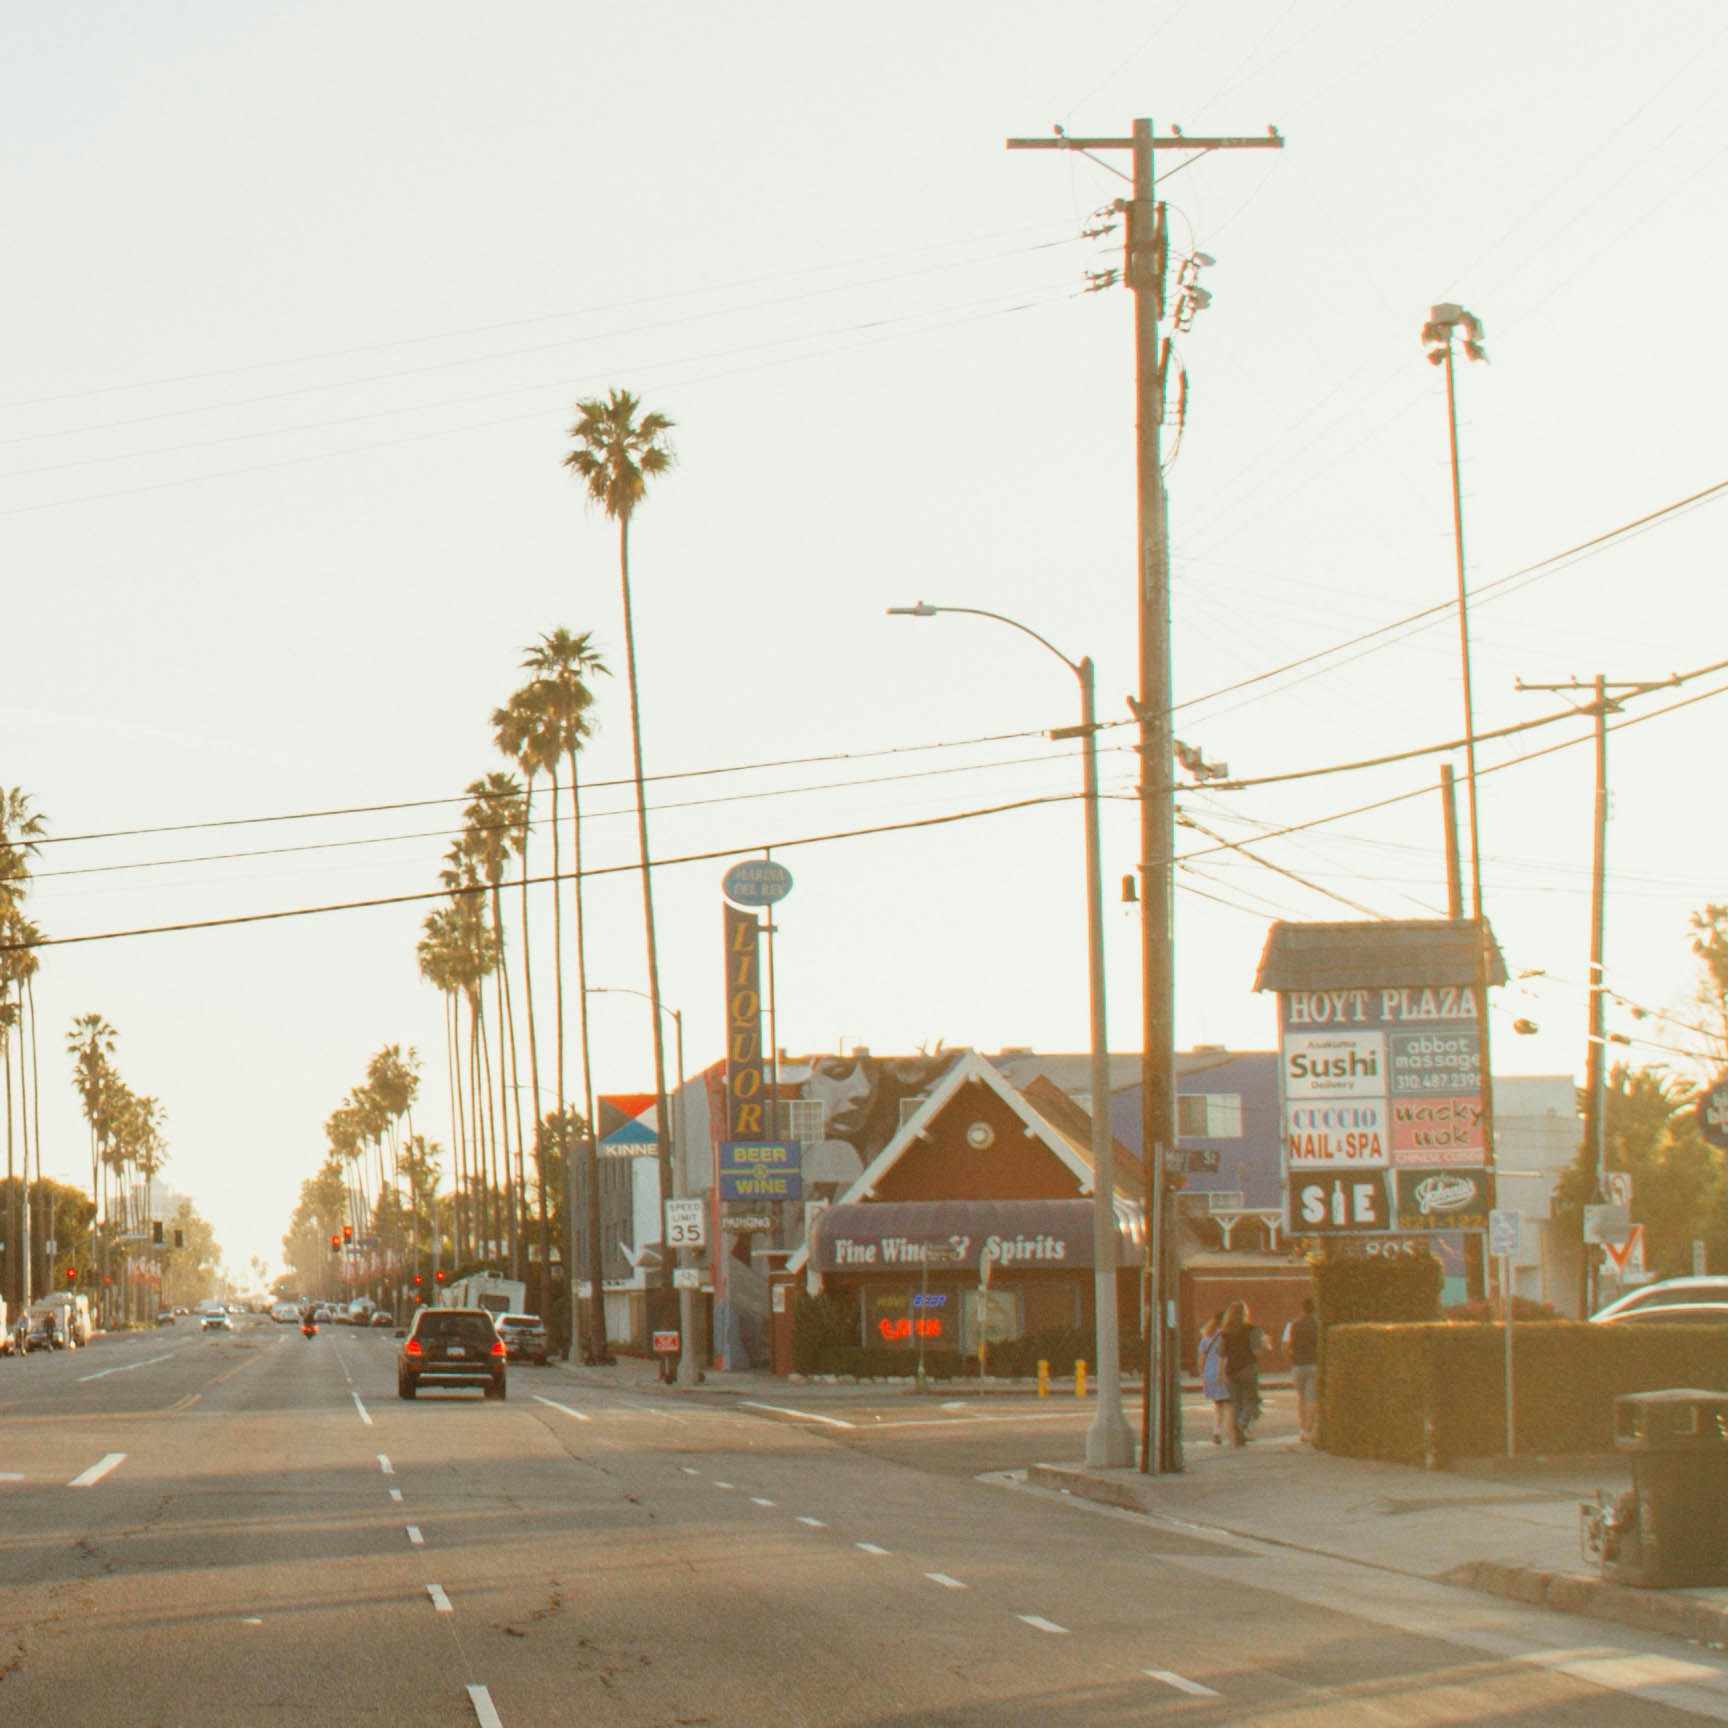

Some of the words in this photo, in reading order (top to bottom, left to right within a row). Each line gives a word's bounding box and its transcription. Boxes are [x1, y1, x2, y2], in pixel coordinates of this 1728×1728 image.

[1289, 989, 1370, 1024] HOYT
[1379, 986, 1479, 1022] PLAZA
[731, 922, 762, 1134] LIQUOR
[1408, 1036, 1471, 1055] abbot
[1289, 1049, 1378, 1079] Sushi
[1292, 1107, 1377, 1129] CUCCIO
[1394, 1099, 1483, 1127] wacky
[1289, 1133, 1335, 1160] NAIL
[1345, 1132, 1383, 1159] SPA
[1413, 1124, 1471, 1147] wok
[605, 1142, 660, 1157] KINNE
[733, 1146, 787, 1163] BEER
[735, 1178, 787, 1194] WINE
[670, 1203, 700, 1212] SPEED
[673, 1213, 698, 1222] LIMIT
[672, 1224, 702, 1242] 35
[834, 1238, 876, 1264] Fine
[986, 1234, 1068, 1267] Spirits
